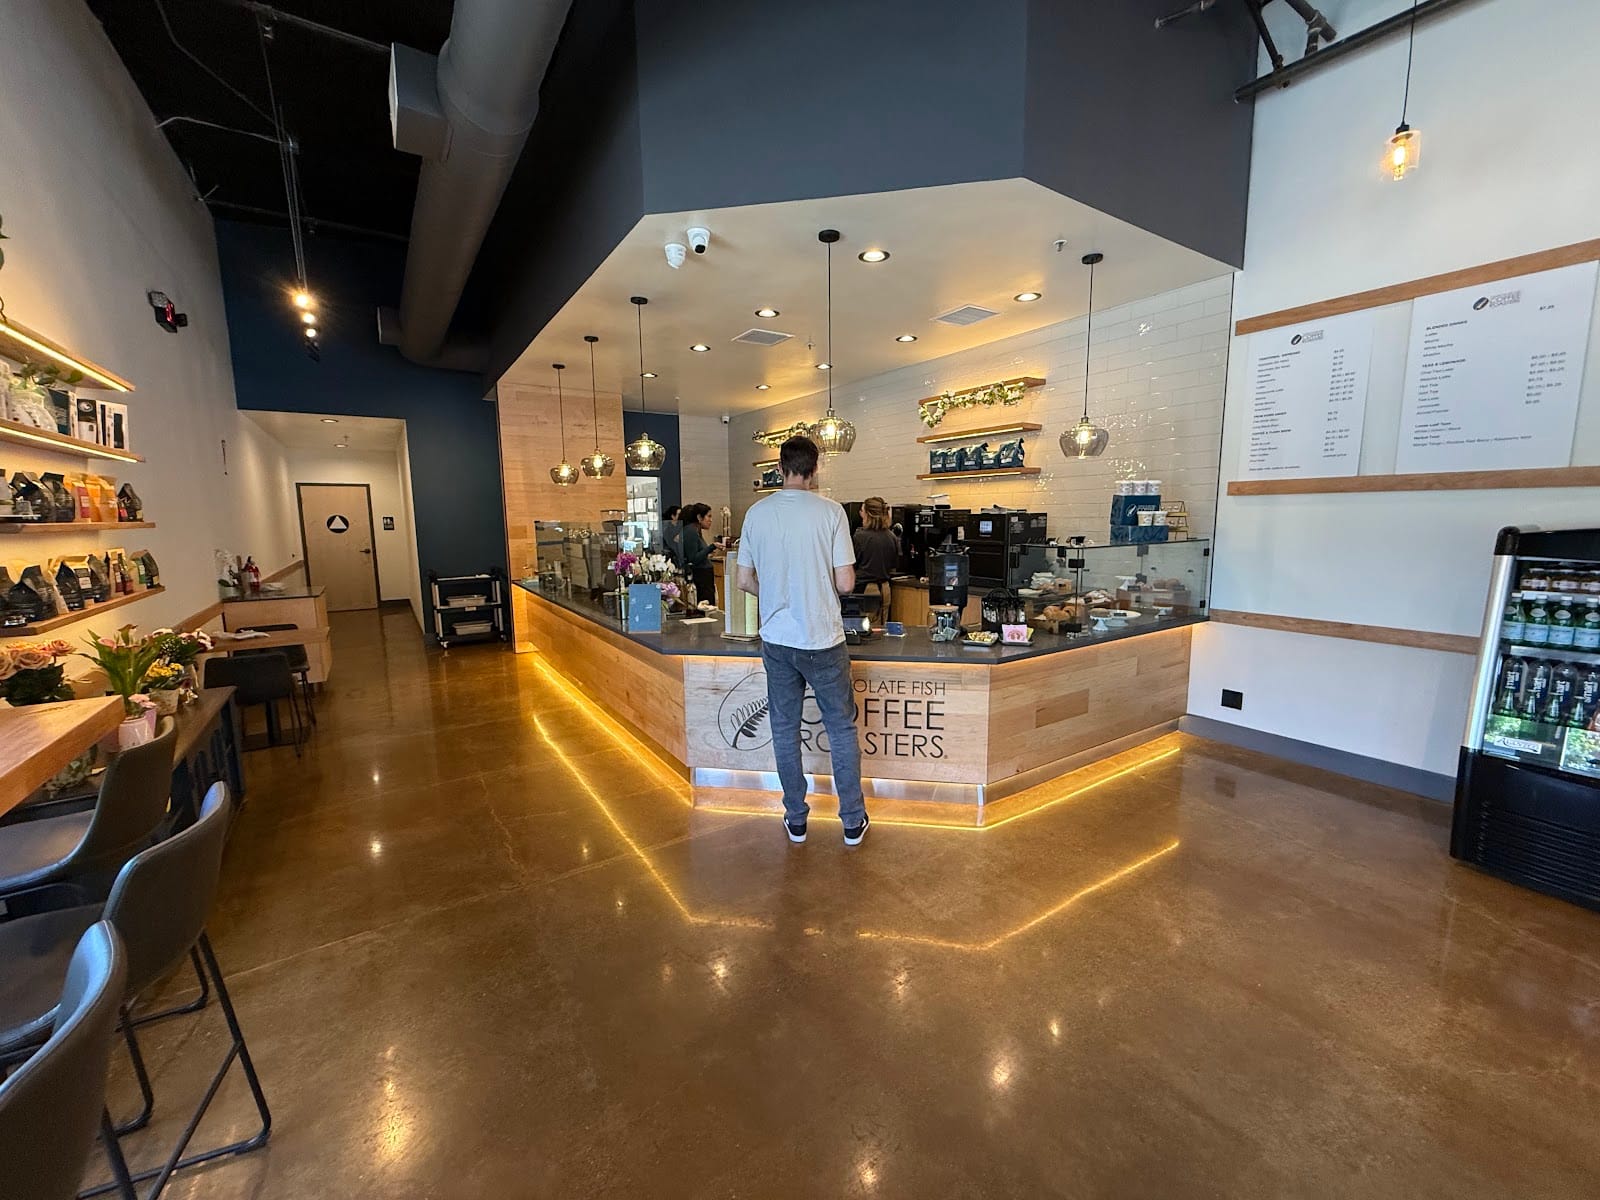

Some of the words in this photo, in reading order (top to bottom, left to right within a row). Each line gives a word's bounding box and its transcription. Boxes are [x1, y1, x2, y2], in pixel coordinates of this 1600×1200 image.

[911, 681, 946, 696] FISH
[801, 695, 945, 731] CFFEE
[799, 729, 945, 759] ROSTERS
